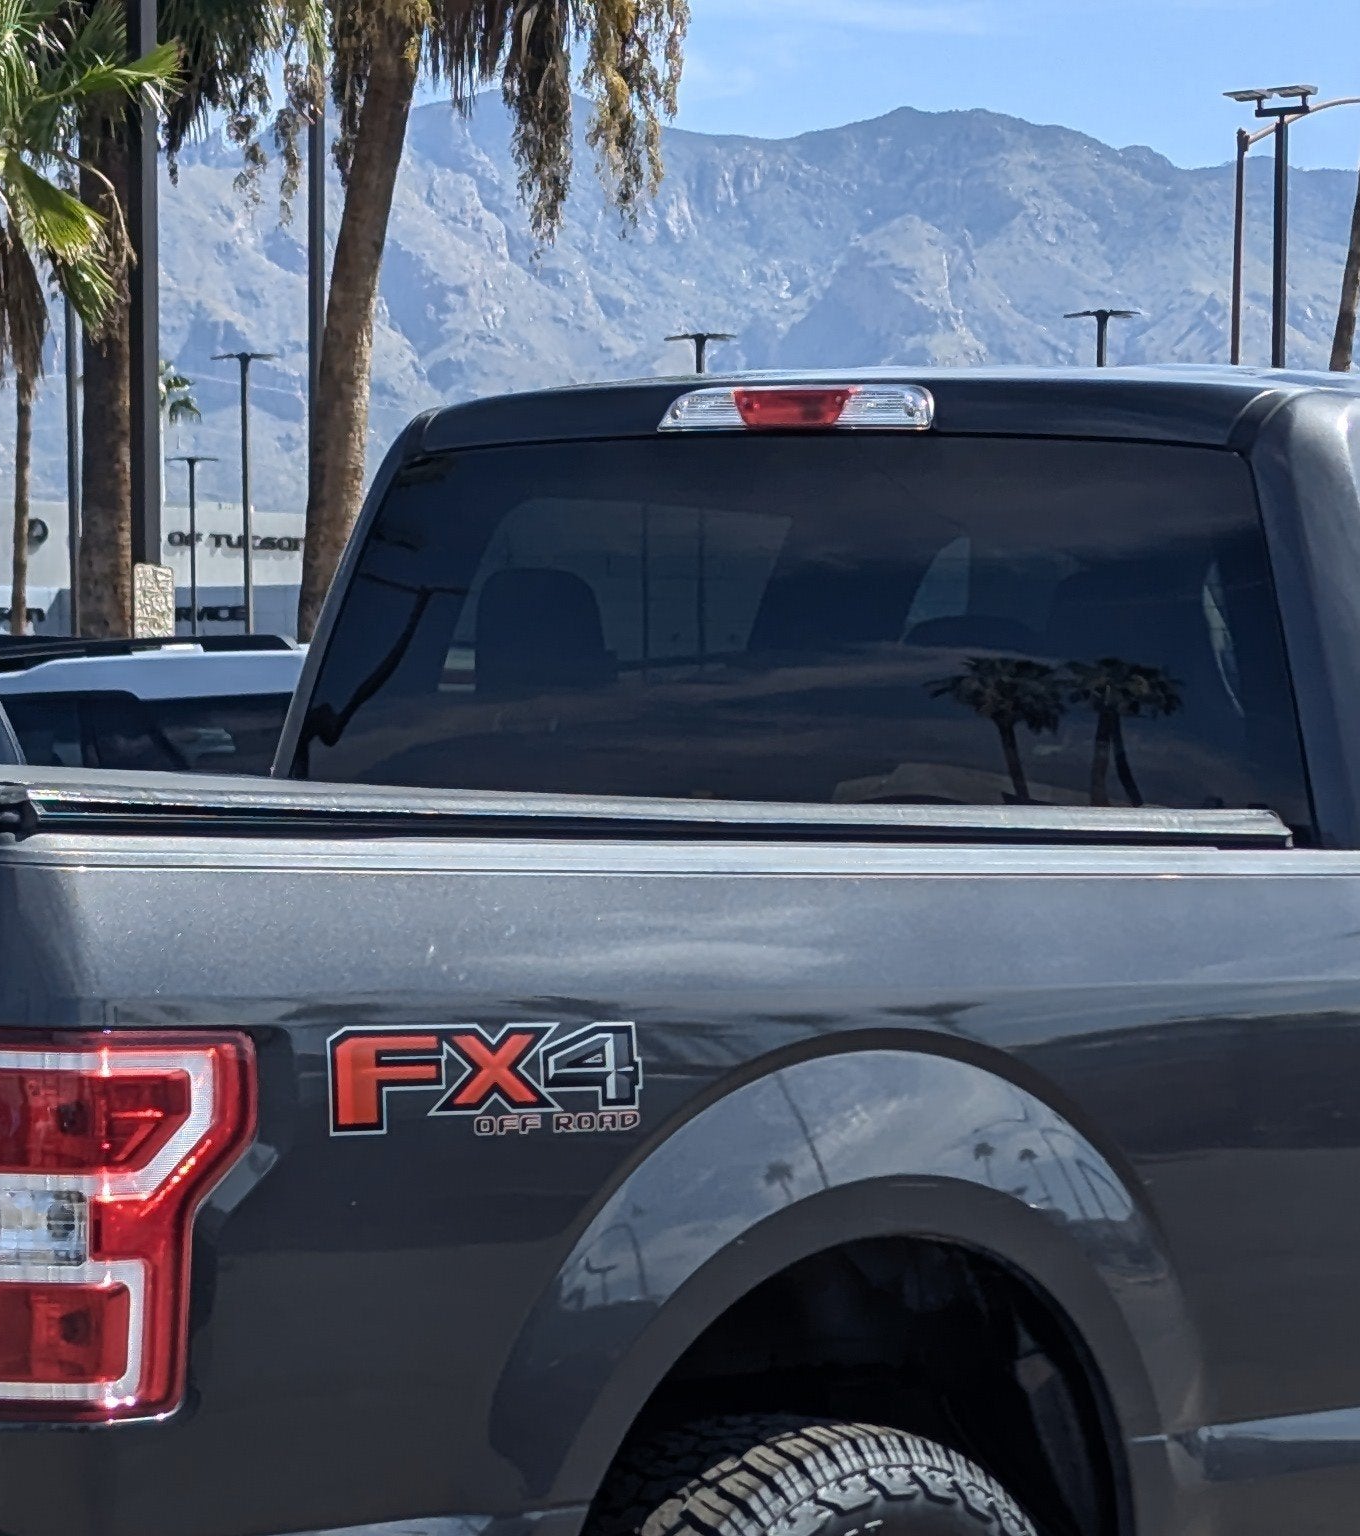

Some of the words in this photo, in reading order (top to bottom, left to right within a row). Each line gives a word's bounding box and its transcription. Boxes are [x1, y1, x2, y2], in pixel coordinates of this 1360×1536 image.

[326, 1021, 643, 1137] FX4
[474, 1114, 542, 1136] OFF
[553, 1110, 642, 1134] ROAD
